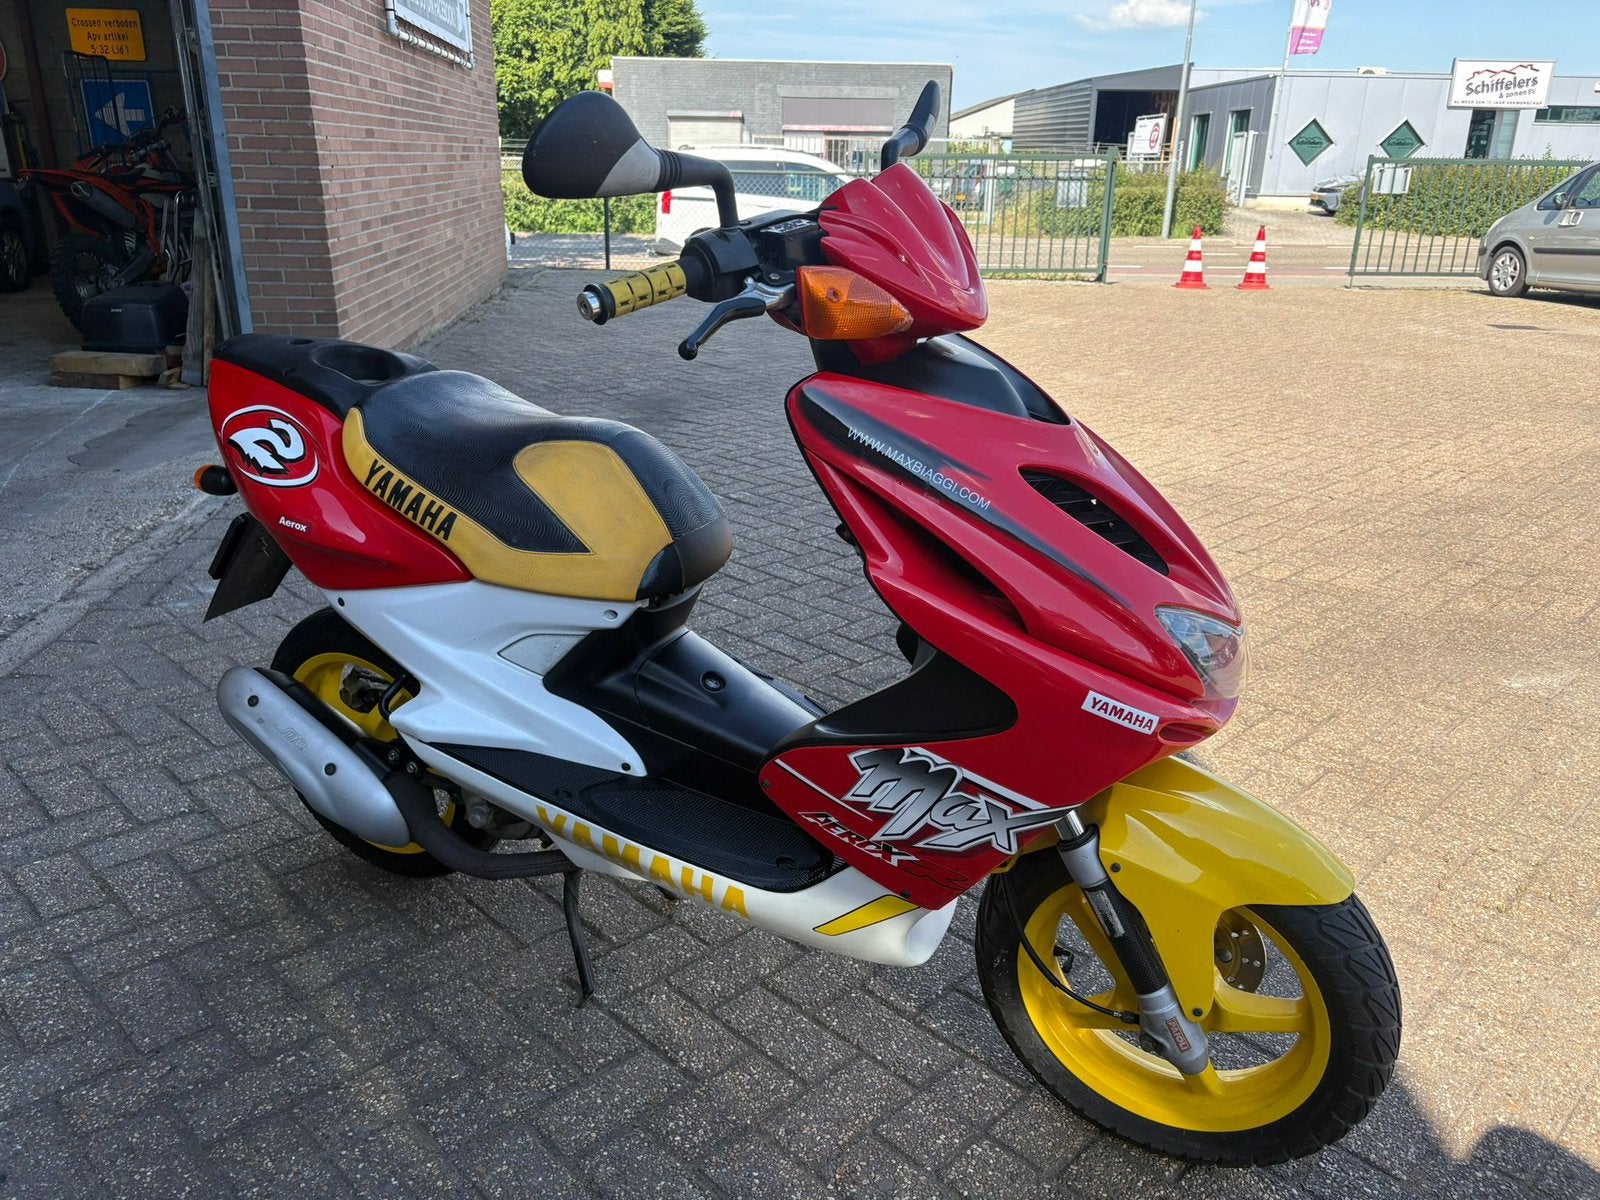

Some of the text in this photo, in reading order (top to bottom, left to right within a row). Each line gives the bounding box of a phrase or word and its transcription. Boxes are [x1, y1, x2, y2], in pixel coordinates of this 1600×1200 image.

[71, 17, 138, 29] Crossen verboden
[103, 31, 129, 41] artikel
[111, 45, 124, 55] Lid
[1465, 76, 1539, 97] Schiffelers
[1505, 90, 1527, 98] zonen
[847, 426, 992, 511] WWW.MAXBIAGGI.COM
[363, 458, 460, 541] YAMAHA
[278, 516, 307, 532] Aerox
[1090, 696, 1154, 731] YAMAHA
[535, 803, 751, 920] YAMAHA
